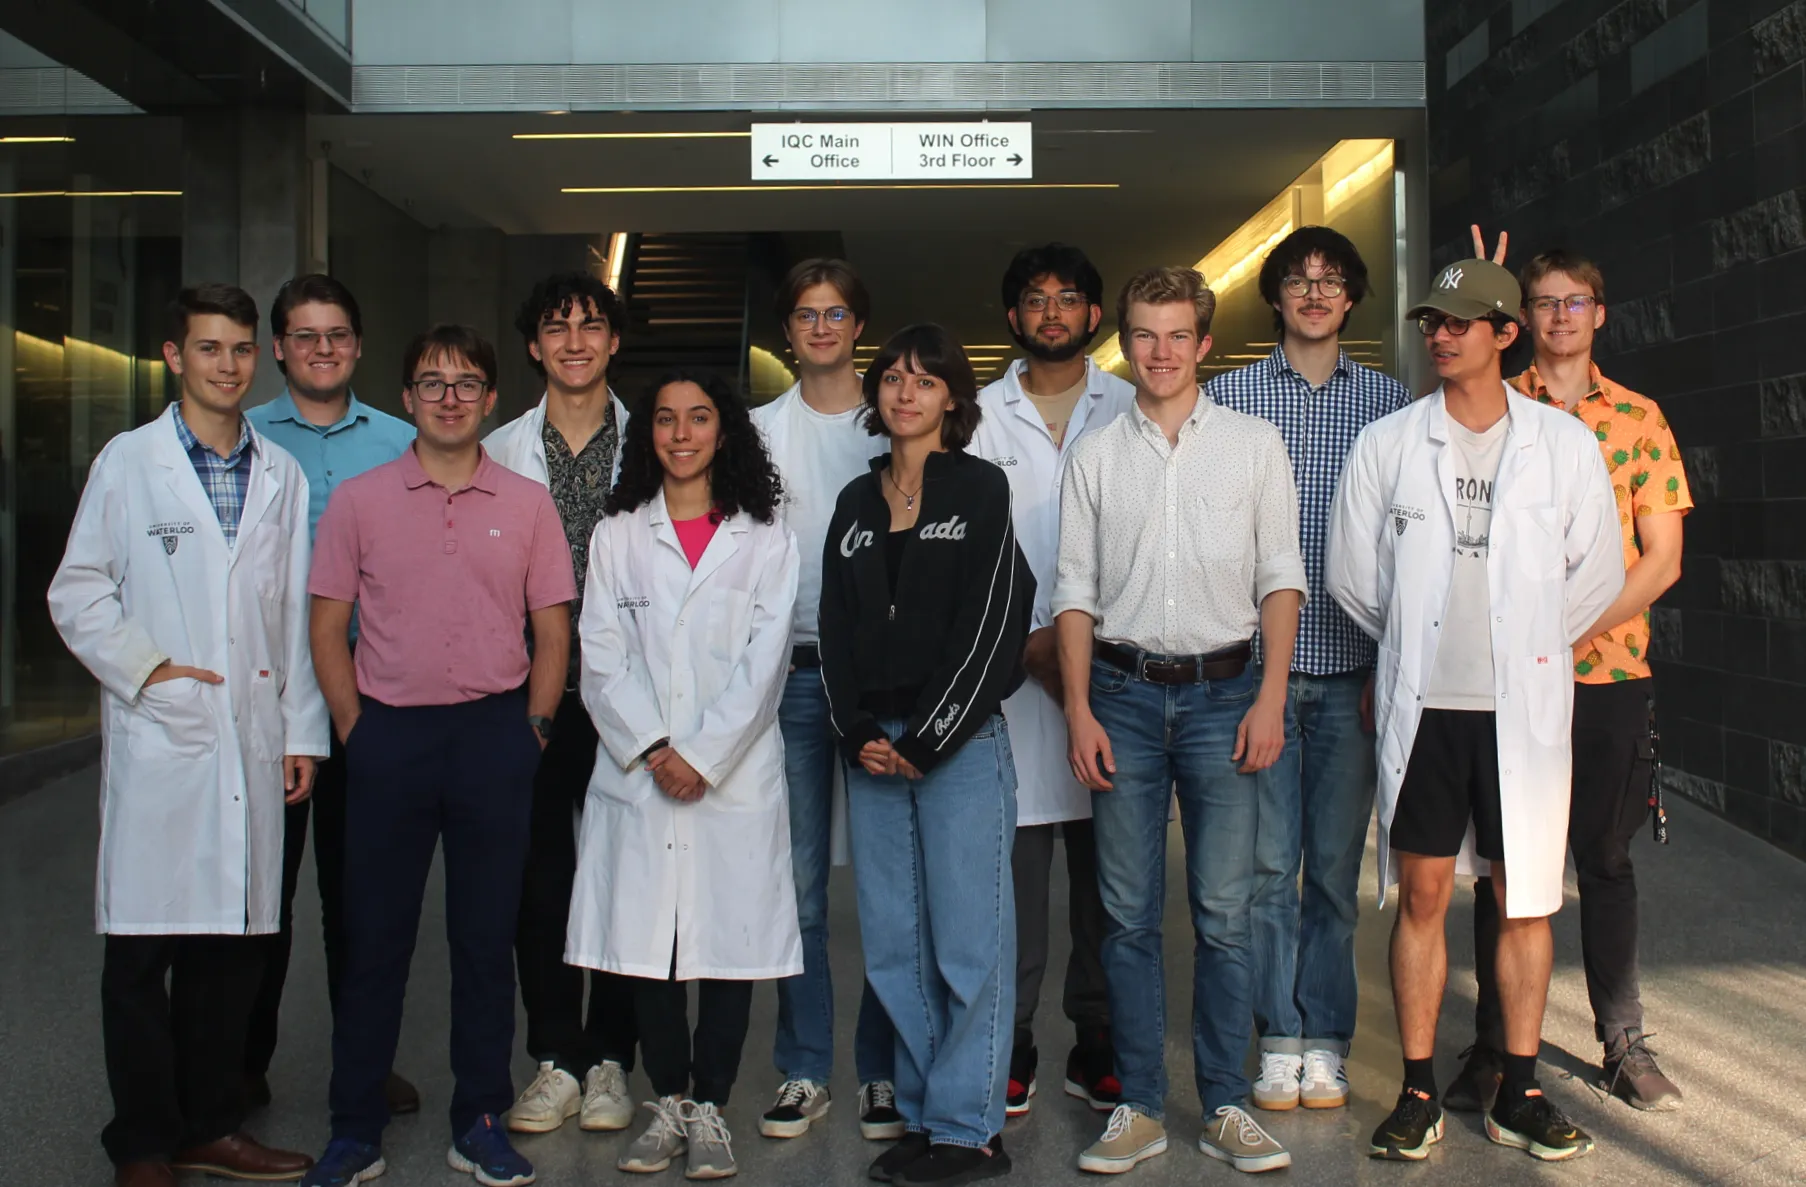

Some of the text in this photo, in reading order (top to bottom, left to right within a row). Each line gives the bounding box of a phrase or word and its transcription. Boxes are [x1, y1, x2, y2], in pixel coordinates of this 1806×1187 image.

[782, 134, 859, 149] IQC Main
[919, 133, 1009, 147] WIN Office
[810, 154, 859, 168] Office
[919, 153, 995, 167] 3rd Floor
[1440, 267, 1464, 289] NY
[1456, 477, 1492, 503] RON
[1389, 507, 1426, 521] ATERLOO
[146, 526, 195, 537] WATERLOO
[934, 703, 960, 736] Roots
